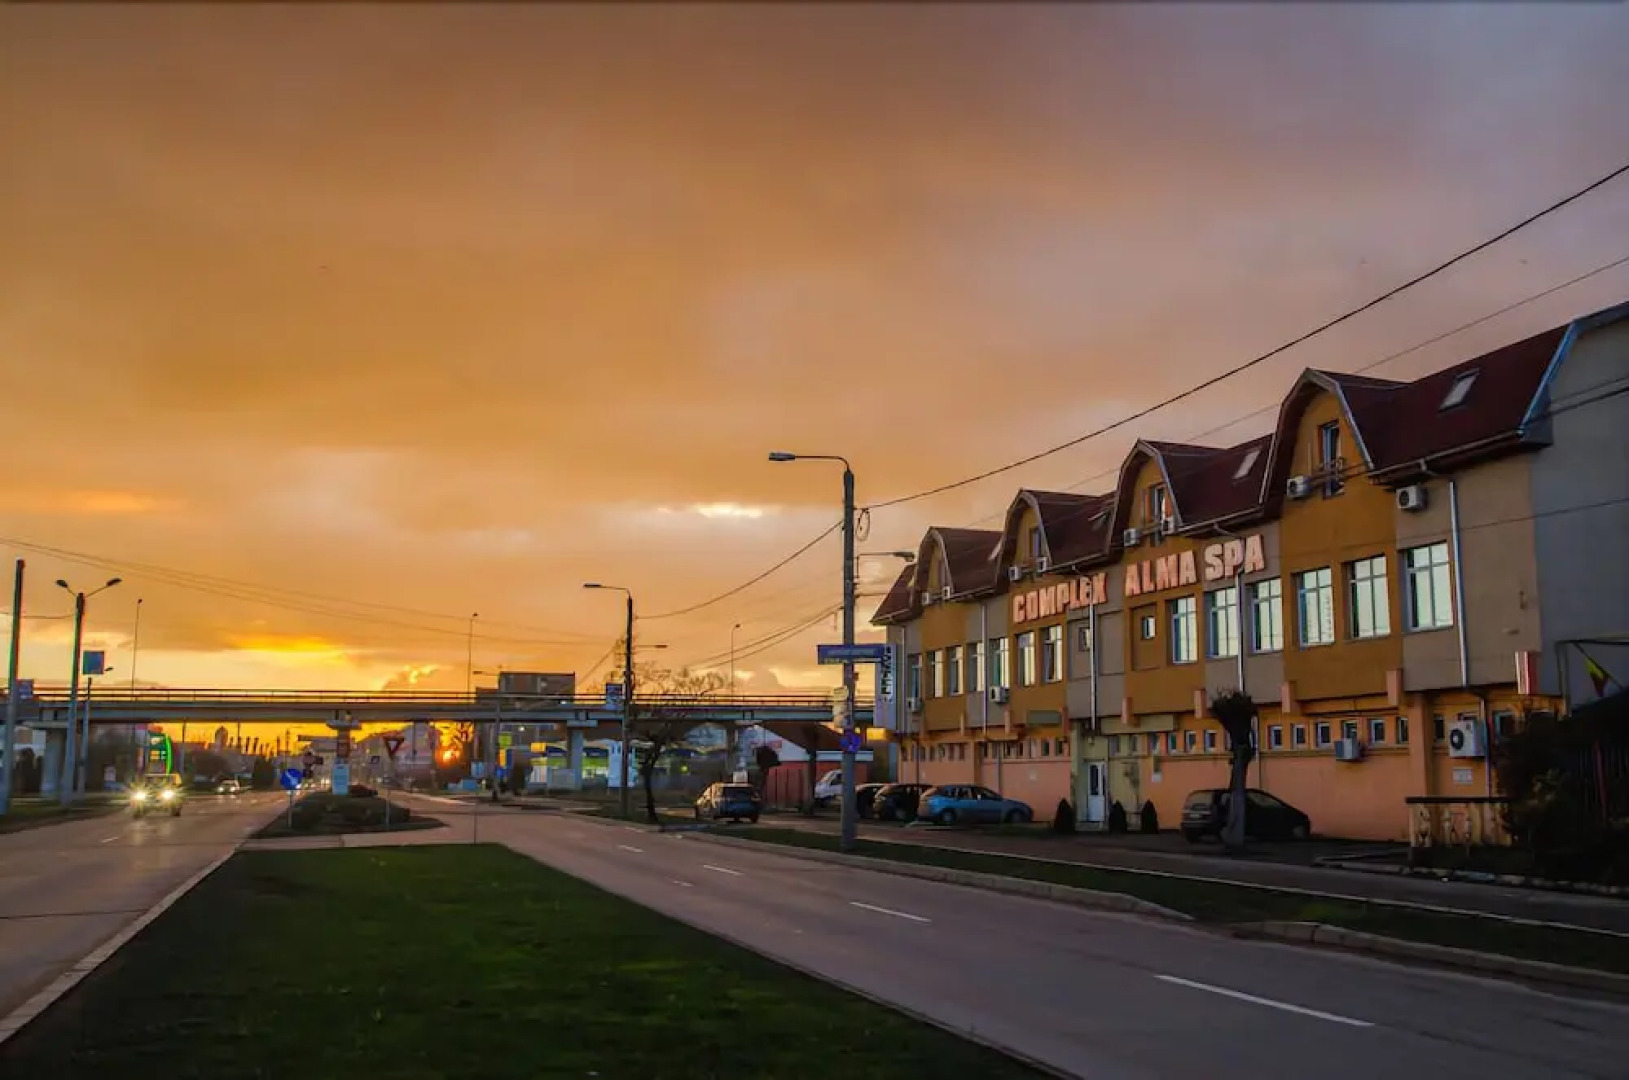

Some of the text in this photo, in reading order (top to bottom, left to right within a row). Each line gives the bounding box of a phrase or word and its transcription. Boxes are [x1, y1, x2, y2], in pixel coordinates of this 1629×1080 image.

[1013, 534, 1265, 622] COMPLEX ALMA SPA
